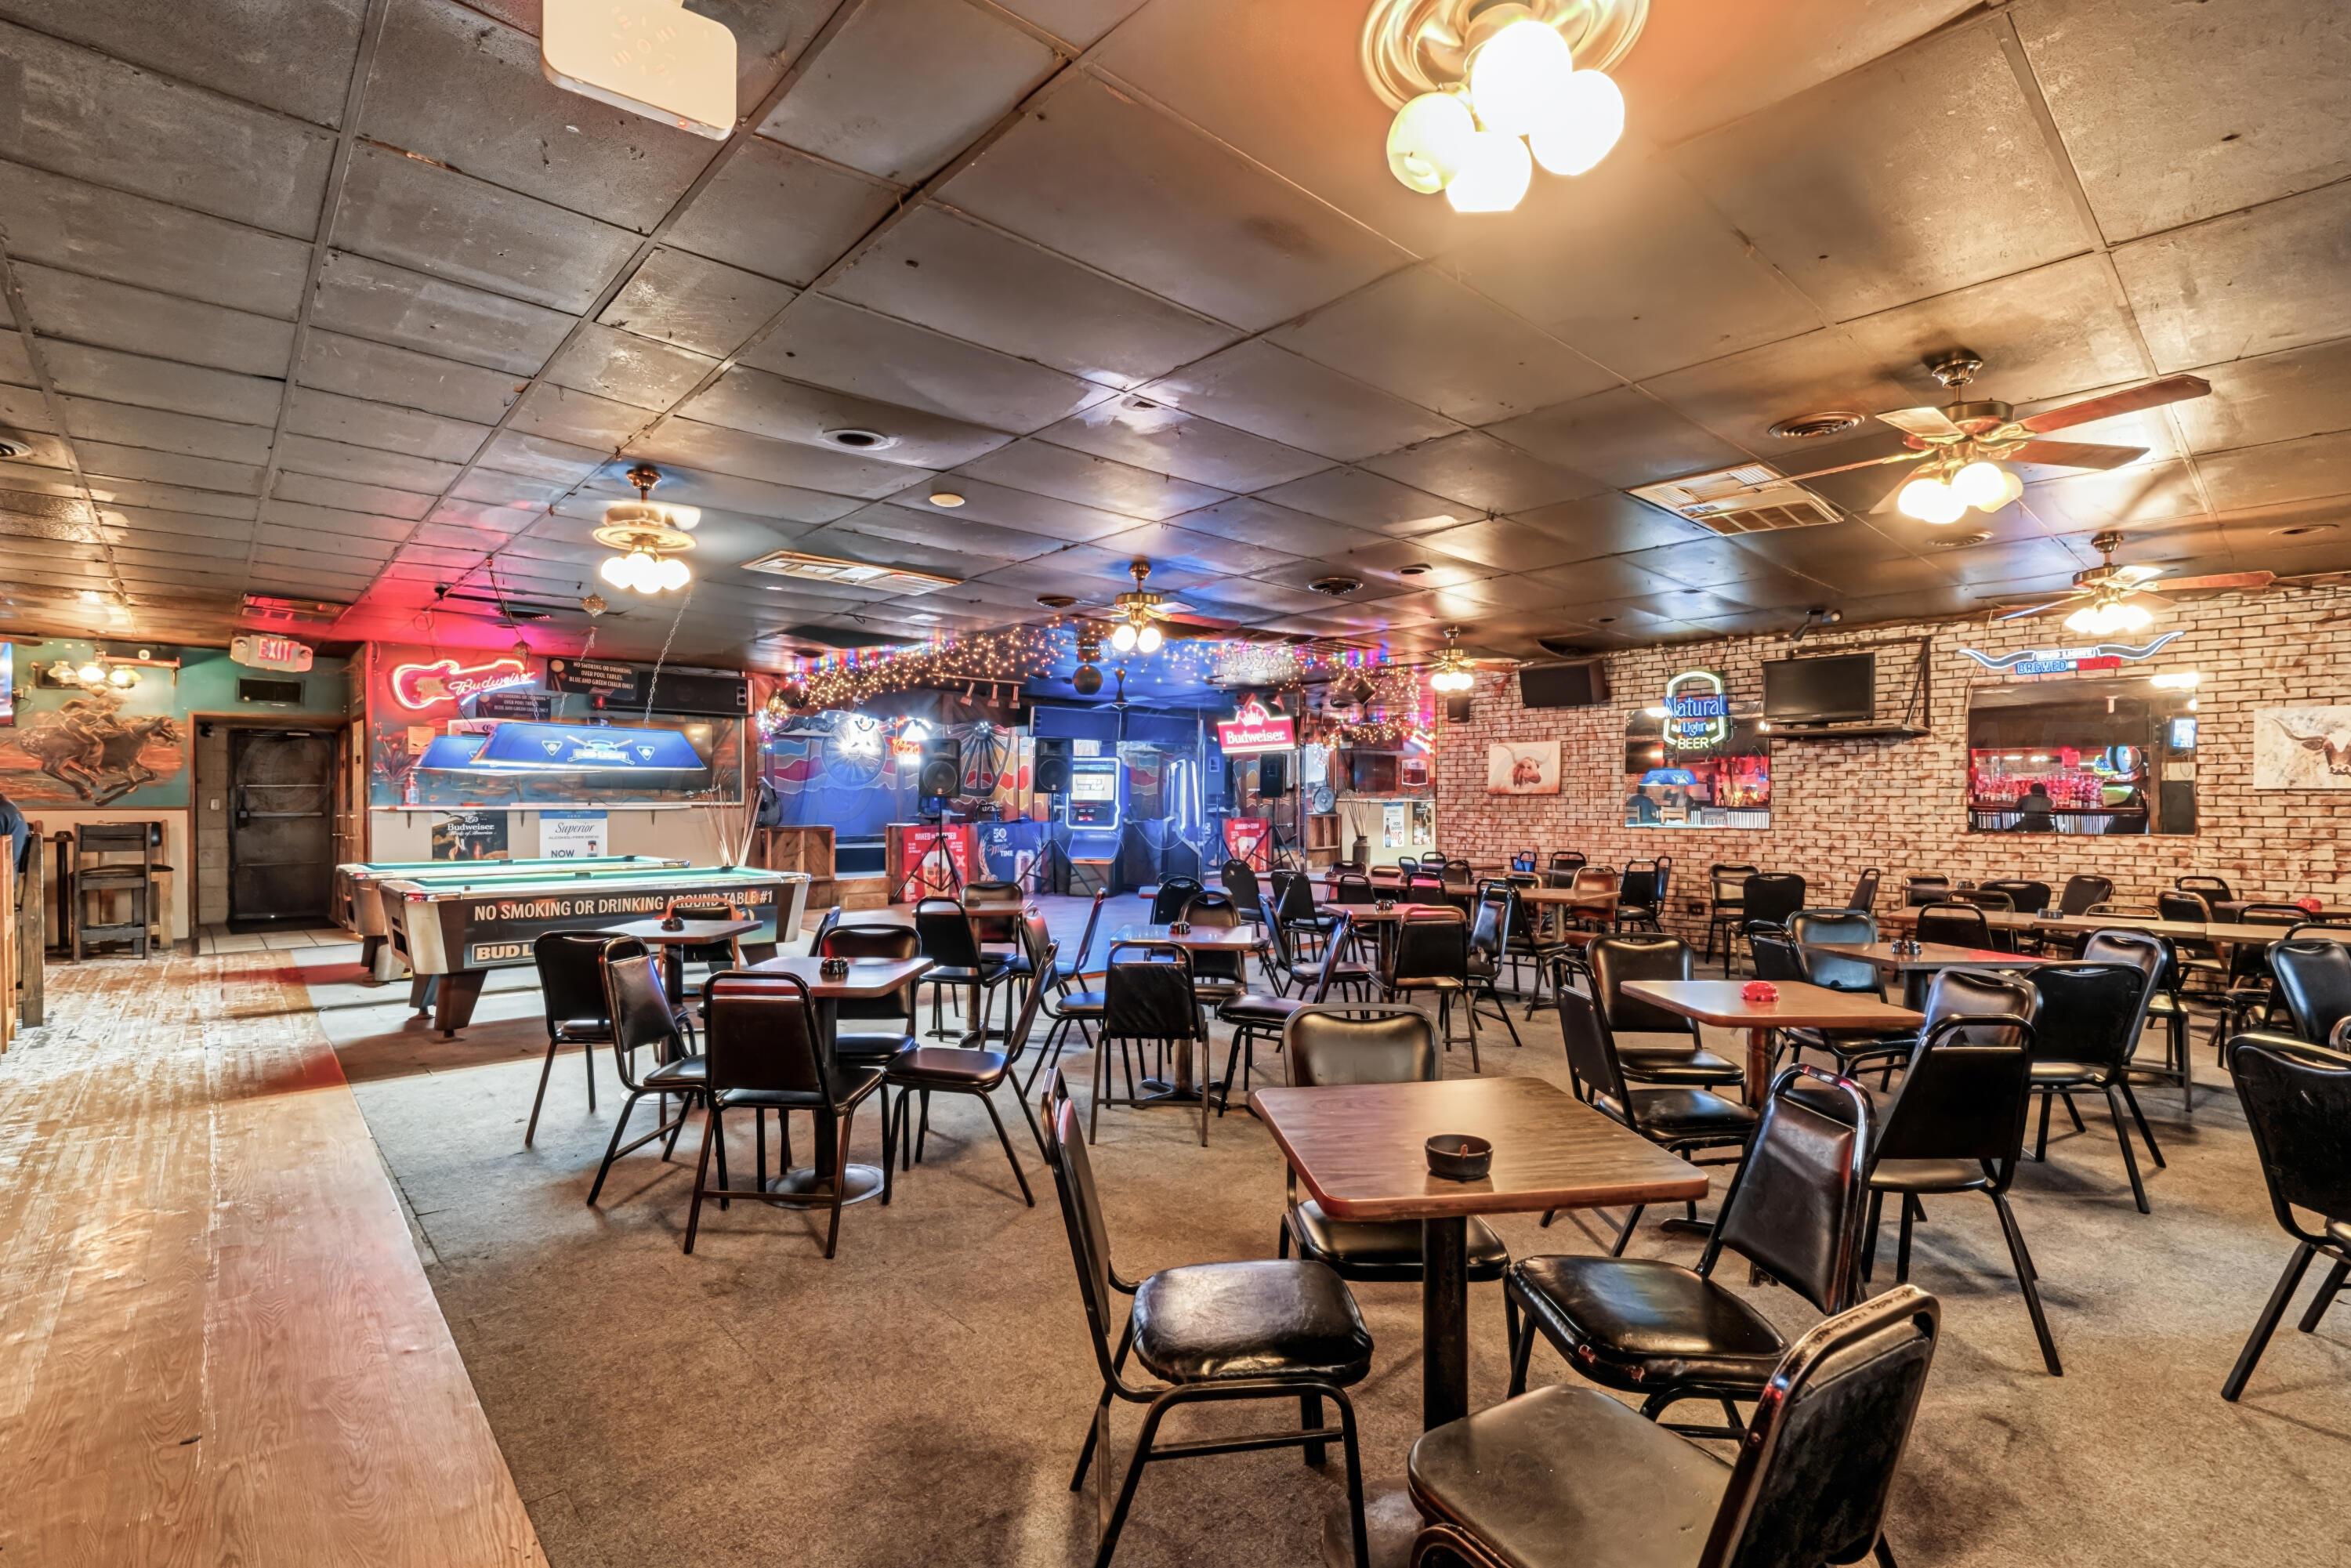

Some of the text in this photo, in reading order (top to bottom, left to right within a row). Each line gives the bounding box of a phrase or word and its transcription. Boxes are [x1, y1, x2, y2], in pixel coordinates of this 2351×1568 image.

[259, 639, 295, 661] EXIT
[610, 665, 632, 674] DRINKING
[2017, 661, 2067, 674] BREWED
[449, 672, 535, 695] Budweiser
[1665, 695, 1725, 718] Natural
[1678, 737, 1709, 749] BEER
[555, 821, 594, 835] Superior
[993, 827, 1007, 839] 50
[474, 906, 497, 921] NO
[500, 901, 571, 919] SMOKING
[574, 900, 595, 914] OR
[599, 896, 664, 913] DRINKING
[723, 891, 758, 906] TABLE
[759, 890, 773, 904] #1
[476, 944, 520, 961] BUD
